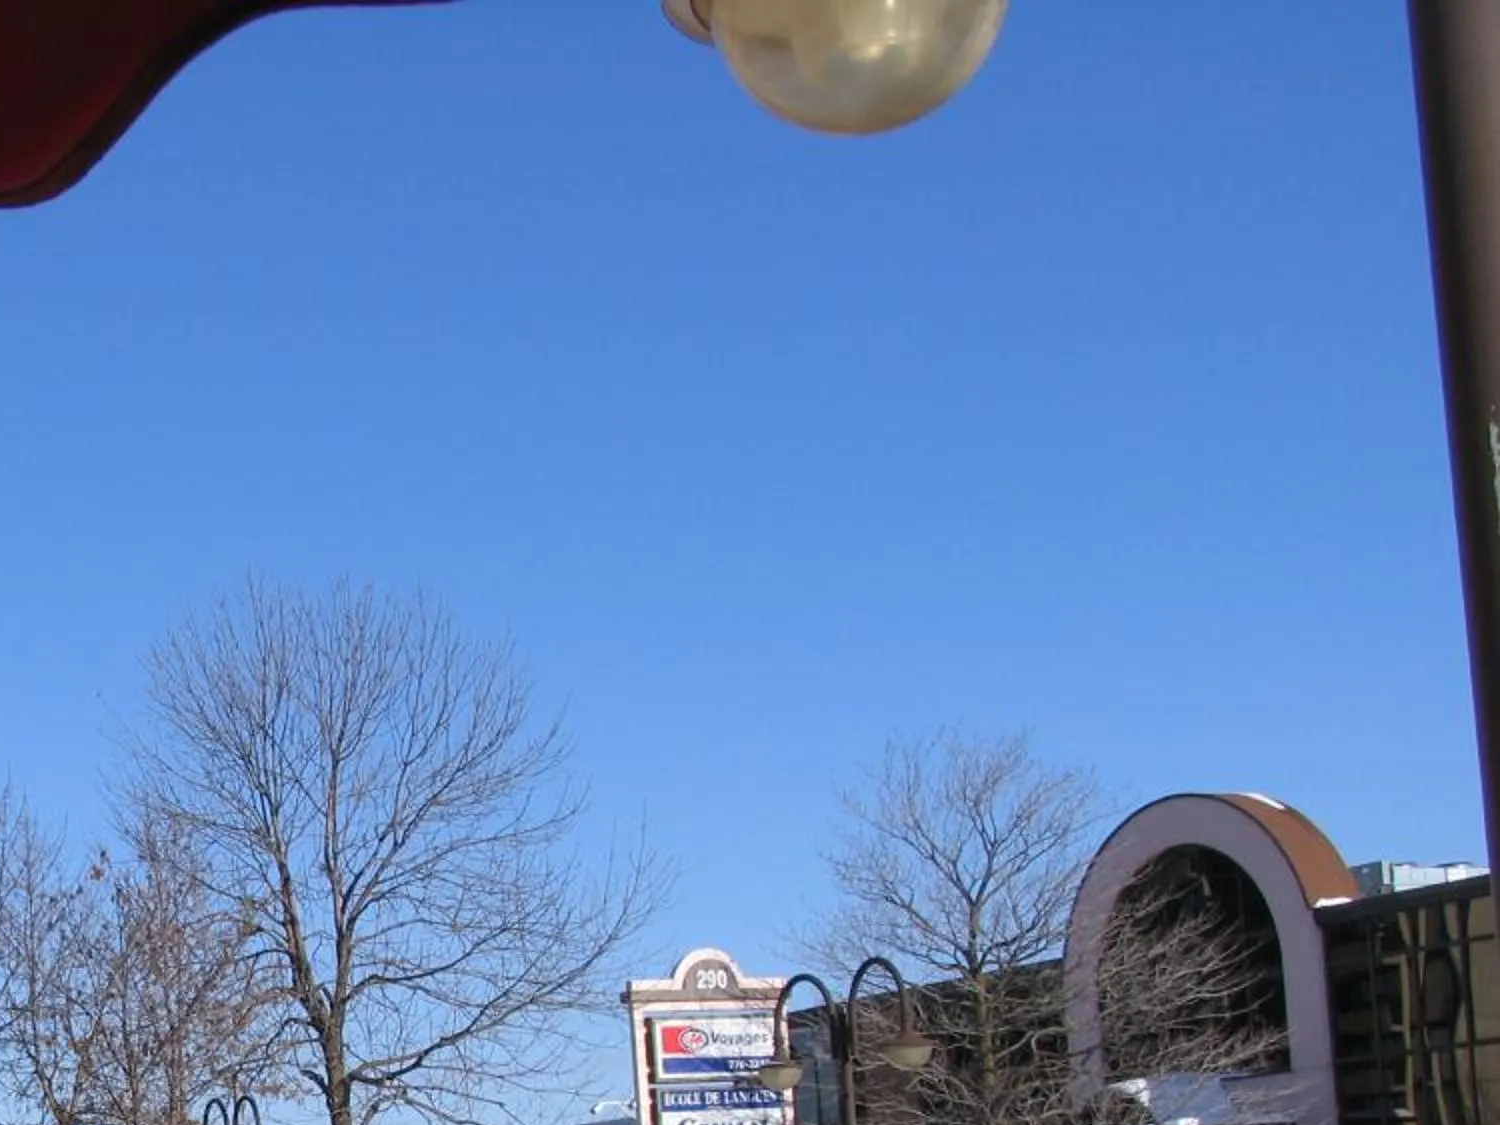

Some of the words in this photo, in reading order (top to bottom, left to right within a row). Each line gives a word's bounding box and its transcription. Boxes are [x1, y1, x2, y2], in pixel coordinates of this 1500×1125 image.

[696, 970, 728, 989] 290
[710, 1030, 768, 1048] Voyages
[705, 1090, 722, 1105] DE
